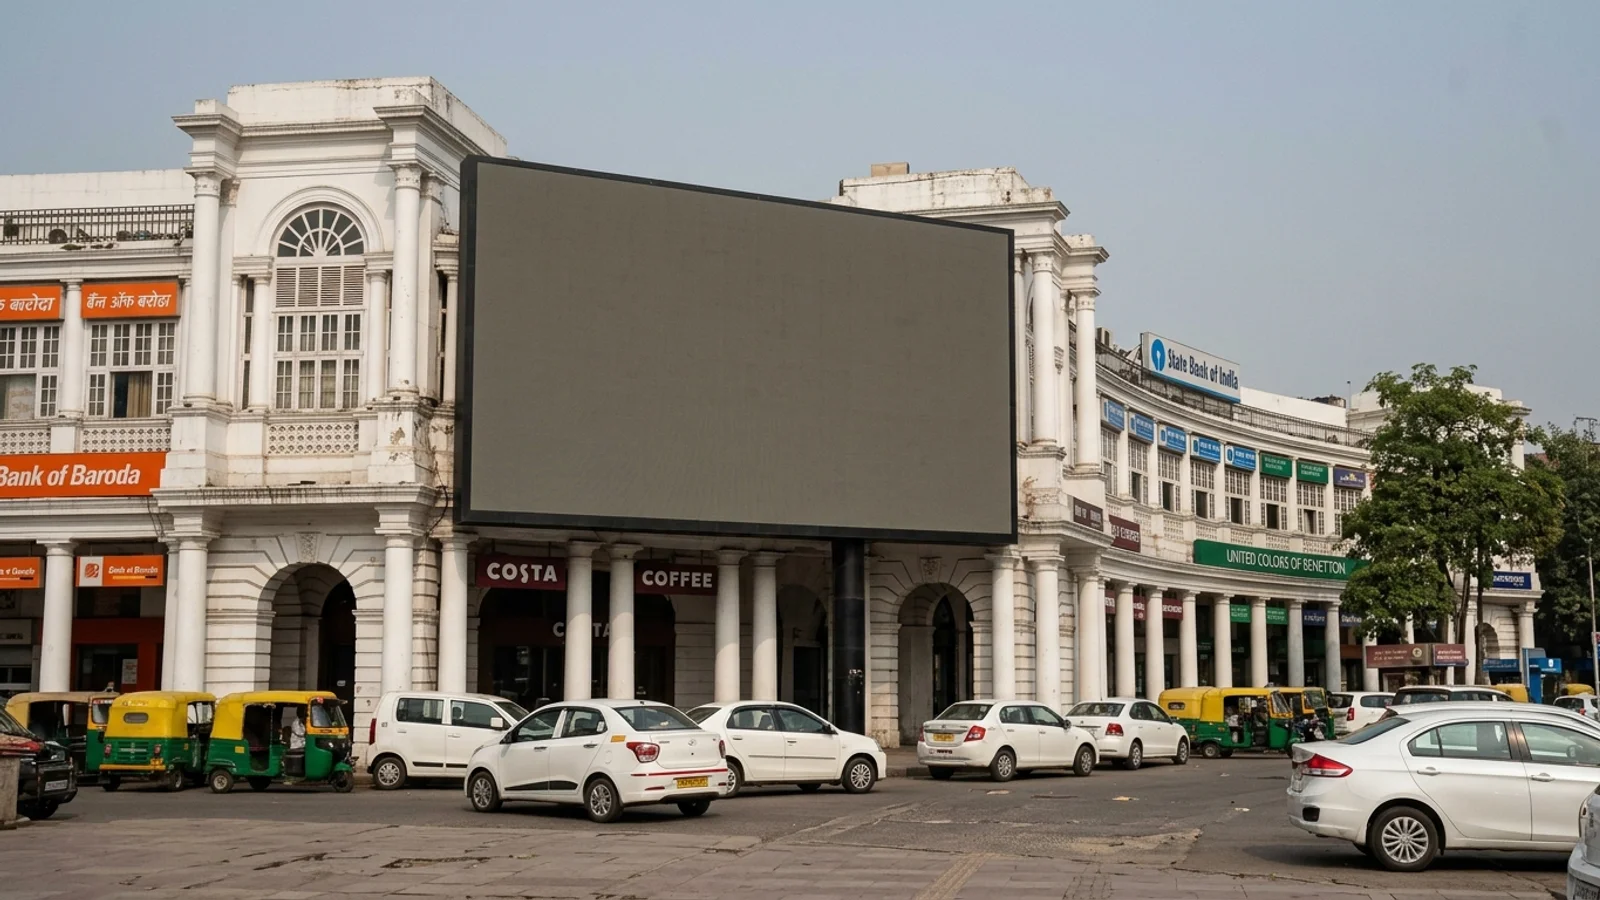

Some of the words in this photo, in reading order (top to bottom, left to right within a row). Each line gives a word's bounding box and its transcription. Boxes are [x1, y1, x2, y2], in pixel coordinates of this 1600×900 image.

[1168, 348, 1187, 373] State
[1189, 355, 1208, 380] Bank
[1210, 364, 1217, 383] of
[1219, 366, 1239, 390] India
[0, 465, 44, 486] Bank
[47, 464, 69, 486] of
[70, 463, 140, 485] Baroda
[486, 562, 558, 584] COSTA
[1226, 549, 1256, 565] UNITED
[1290, 557, 1302, 570] OF
[1303, 558, 1346, 574] BENETTON
[642, 570, 713, 588] COFFEE
